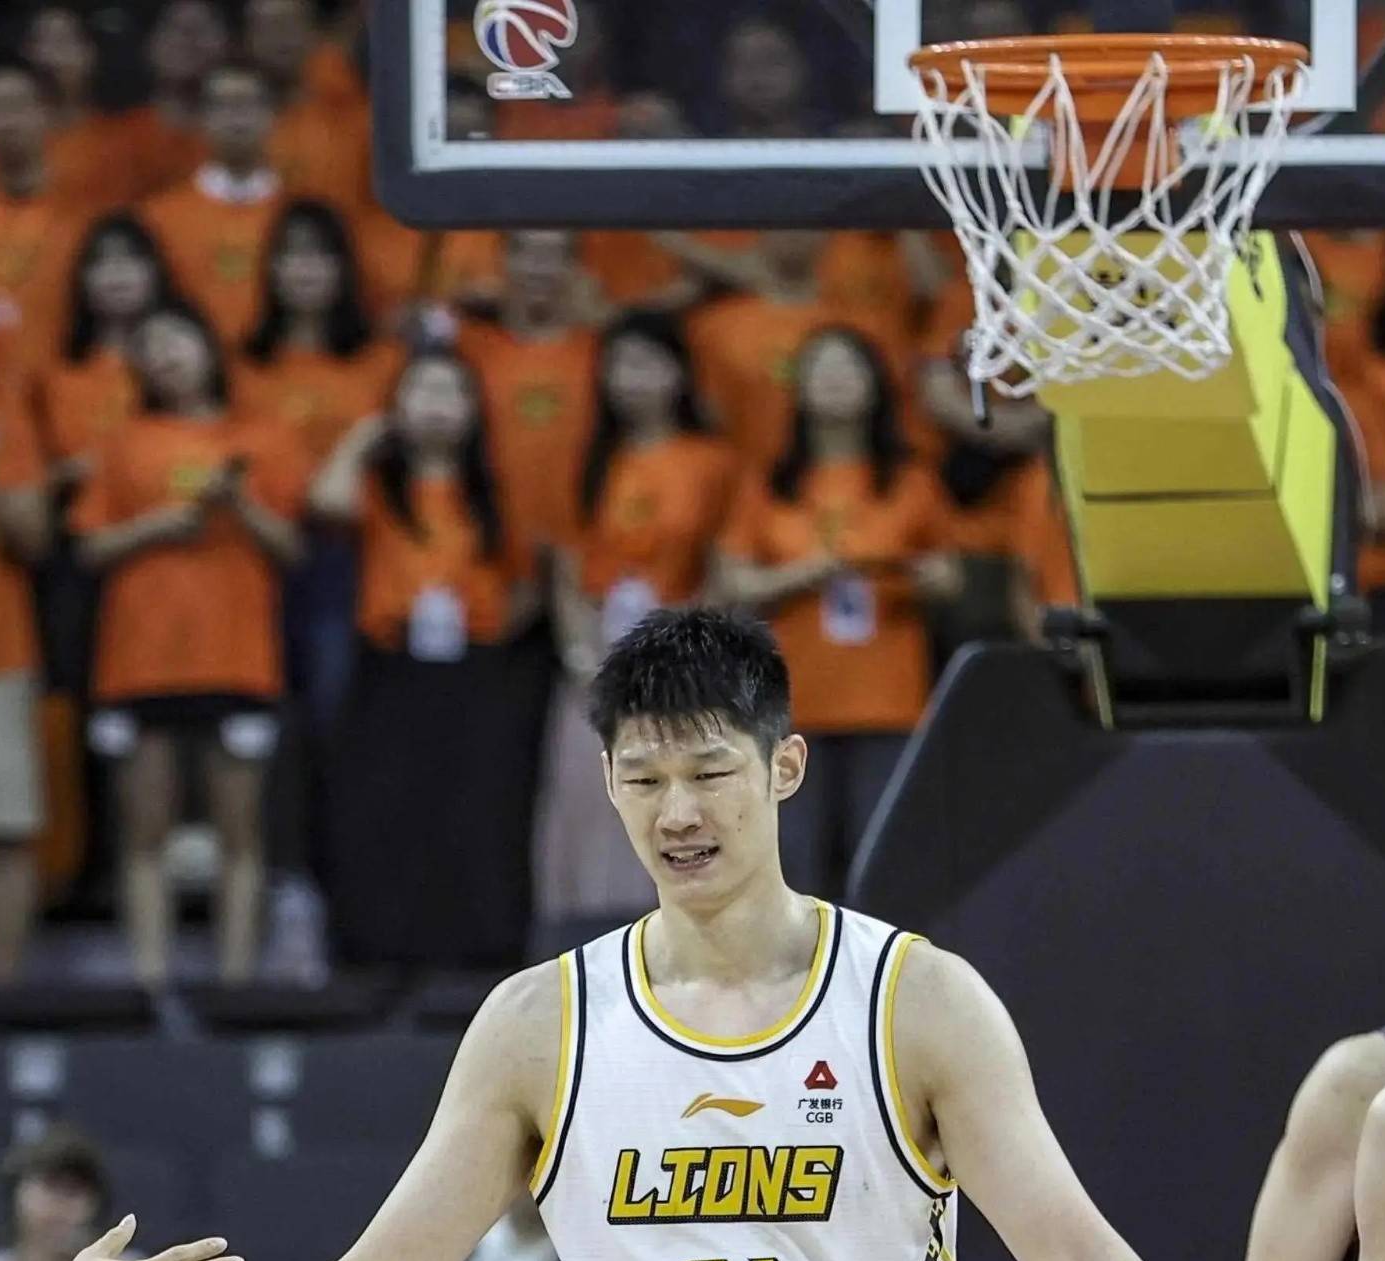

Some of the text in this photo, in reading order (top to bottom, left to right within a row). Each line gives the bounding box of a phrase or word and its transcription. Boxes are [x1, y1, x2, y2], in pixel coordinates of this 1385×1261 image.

[797, 1098, 843, 1110] 广发银行
[805, 1111, 834, 1124] CGB
[607, 1145, 844, 1225] LIONS
